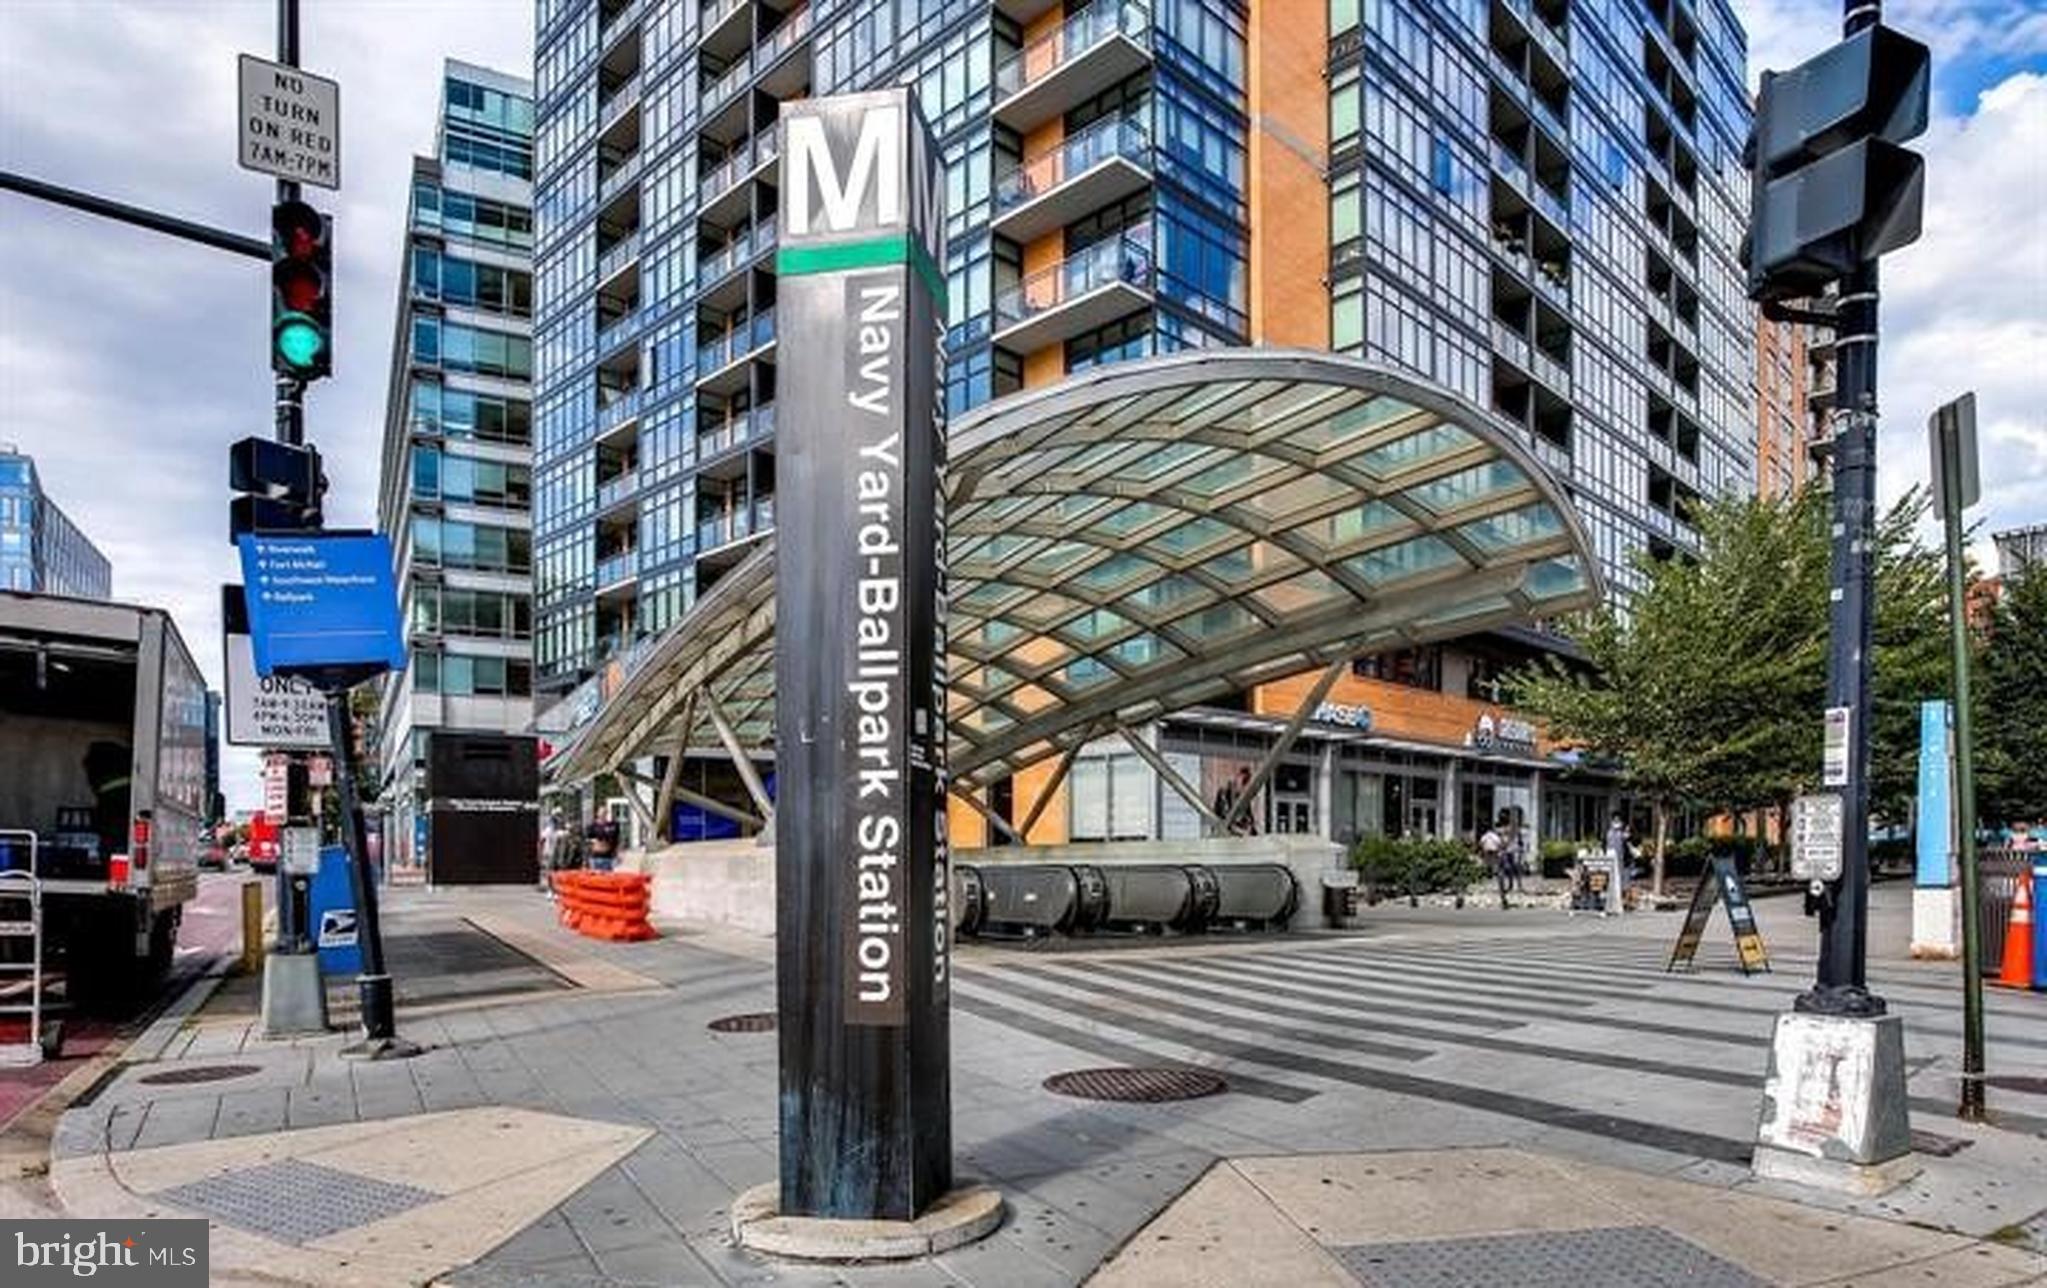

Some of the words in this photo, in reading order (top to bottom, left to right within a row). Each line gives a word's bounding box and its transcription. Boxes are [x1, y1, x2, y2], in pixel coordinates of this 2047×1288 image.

[250, 116, 279, 138] ON
[291, 128, 331, 152] RED
[262, 95, 319, 125] TURN
[274, 72, 303, 94] NO
[250, 142, 331, 176] 7AM-7PM
[788, 106, 899, 235] M
[911, 110, 947, 278] M
[849, 286, 899, 415] Navy
[932, 317, 948, 443] Navy
[848, 432, 899, 798] Yard-Ballpark
[859, 815, 900, 1003] Station
[934, 810, 948, 983] Station
